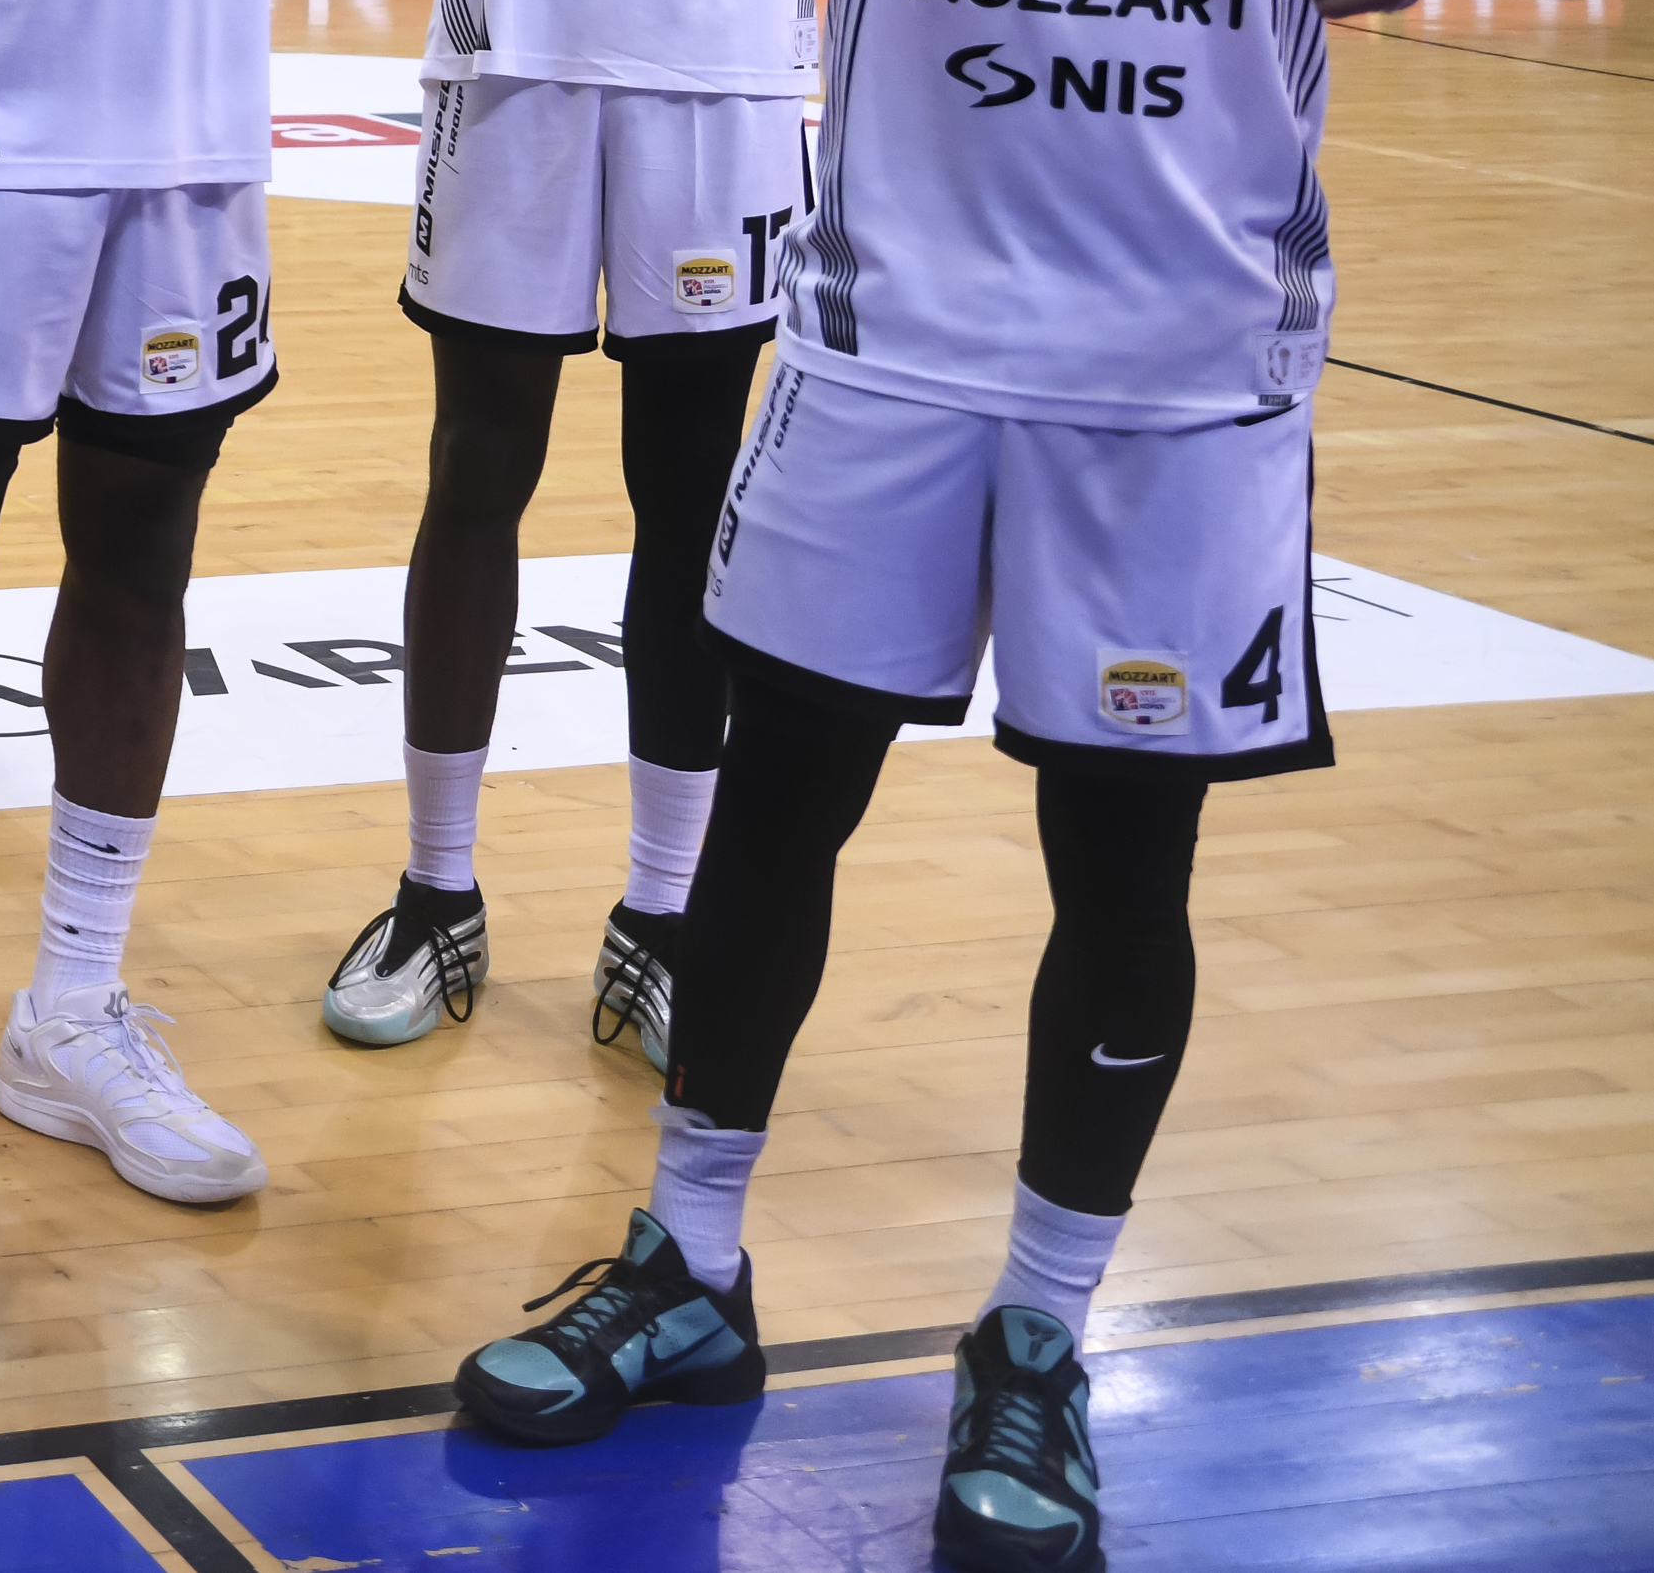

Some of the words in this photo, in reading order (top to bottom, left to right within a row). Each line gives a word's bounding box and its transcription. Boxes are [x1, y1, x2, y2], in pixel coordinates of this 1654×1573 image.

[1049, 58, 1187, 119] NIS
[446, 83, 464, 158] GROUP
[680, 265, 730, 275] MOZZART
[147, 338, 195, 352] MOZZART
[734, 363, 790, 503] MILSPE
[1108, 670, 1177, 684] MOZZART
[1220, 604, 1286, 725] 4
